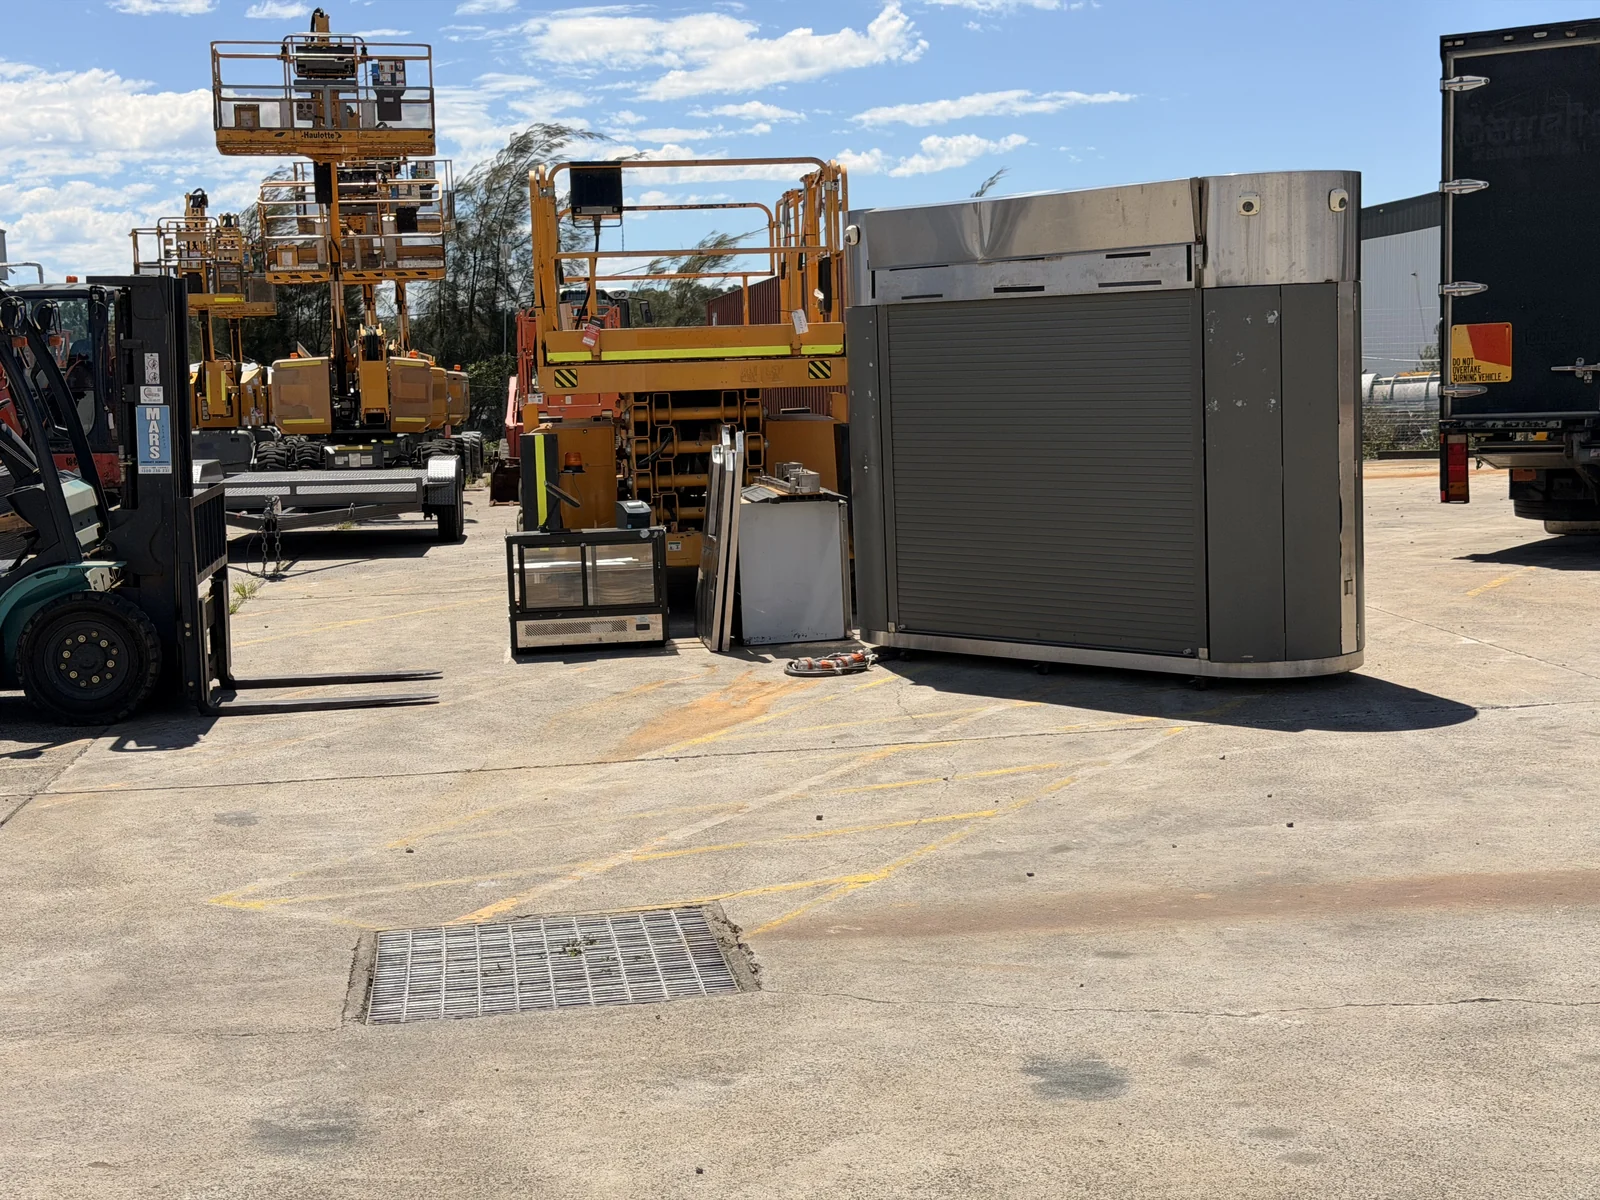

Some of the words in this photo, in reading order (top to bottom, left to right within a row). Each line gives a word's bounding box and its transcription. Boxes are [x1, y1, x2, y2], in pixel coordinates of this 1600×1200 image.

[303, 131, 335, 139] Haulotte
[1452, 358, 1461, 366] DO
[1463, 357, 1474, 366] NOT
[1452, 365, 1481, 374] OVERTAKE
[1452, 374, 1477, 382] TURNING
[1478, 372, 1502, 381] VEHICLE
[145, 407, 160, 459] MARS
